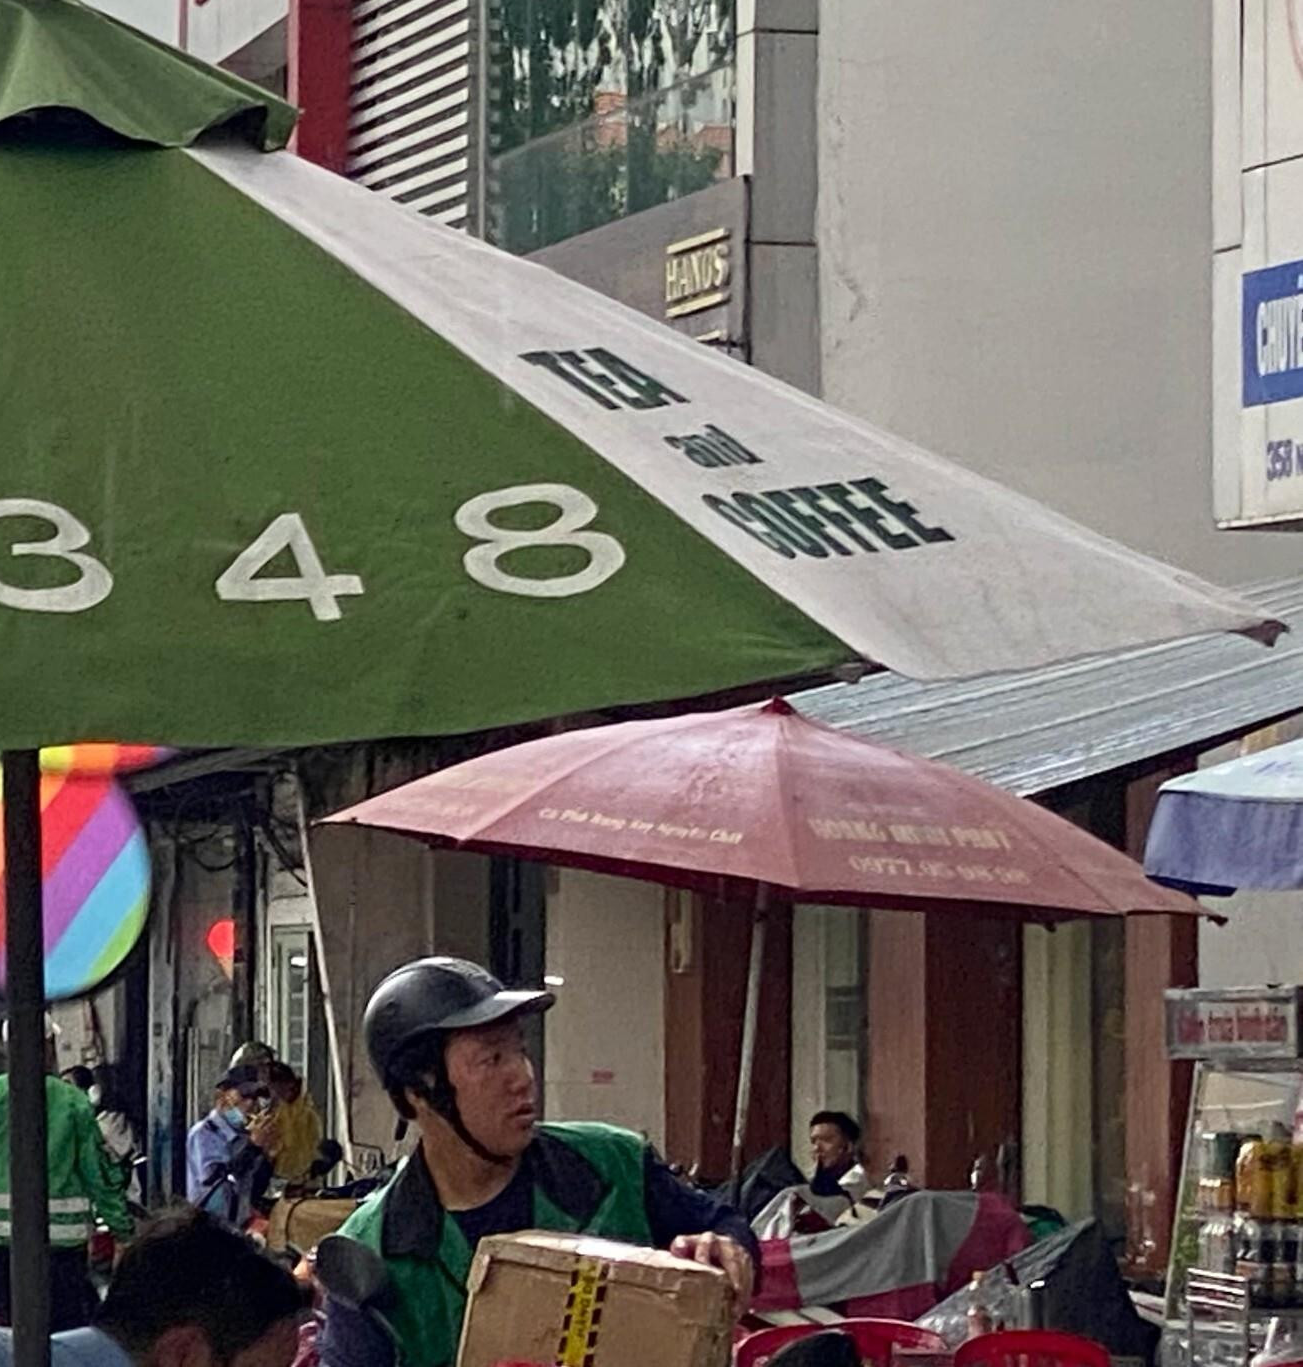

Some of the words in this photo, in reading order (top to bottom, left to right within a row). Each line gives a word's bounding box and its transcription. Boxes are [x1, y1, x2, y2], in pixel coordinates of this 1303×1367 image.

[518, 347, 692, 411] TEA
[663, 423, 765, 468] and
[701, 476, 956, 560] COFFEE
